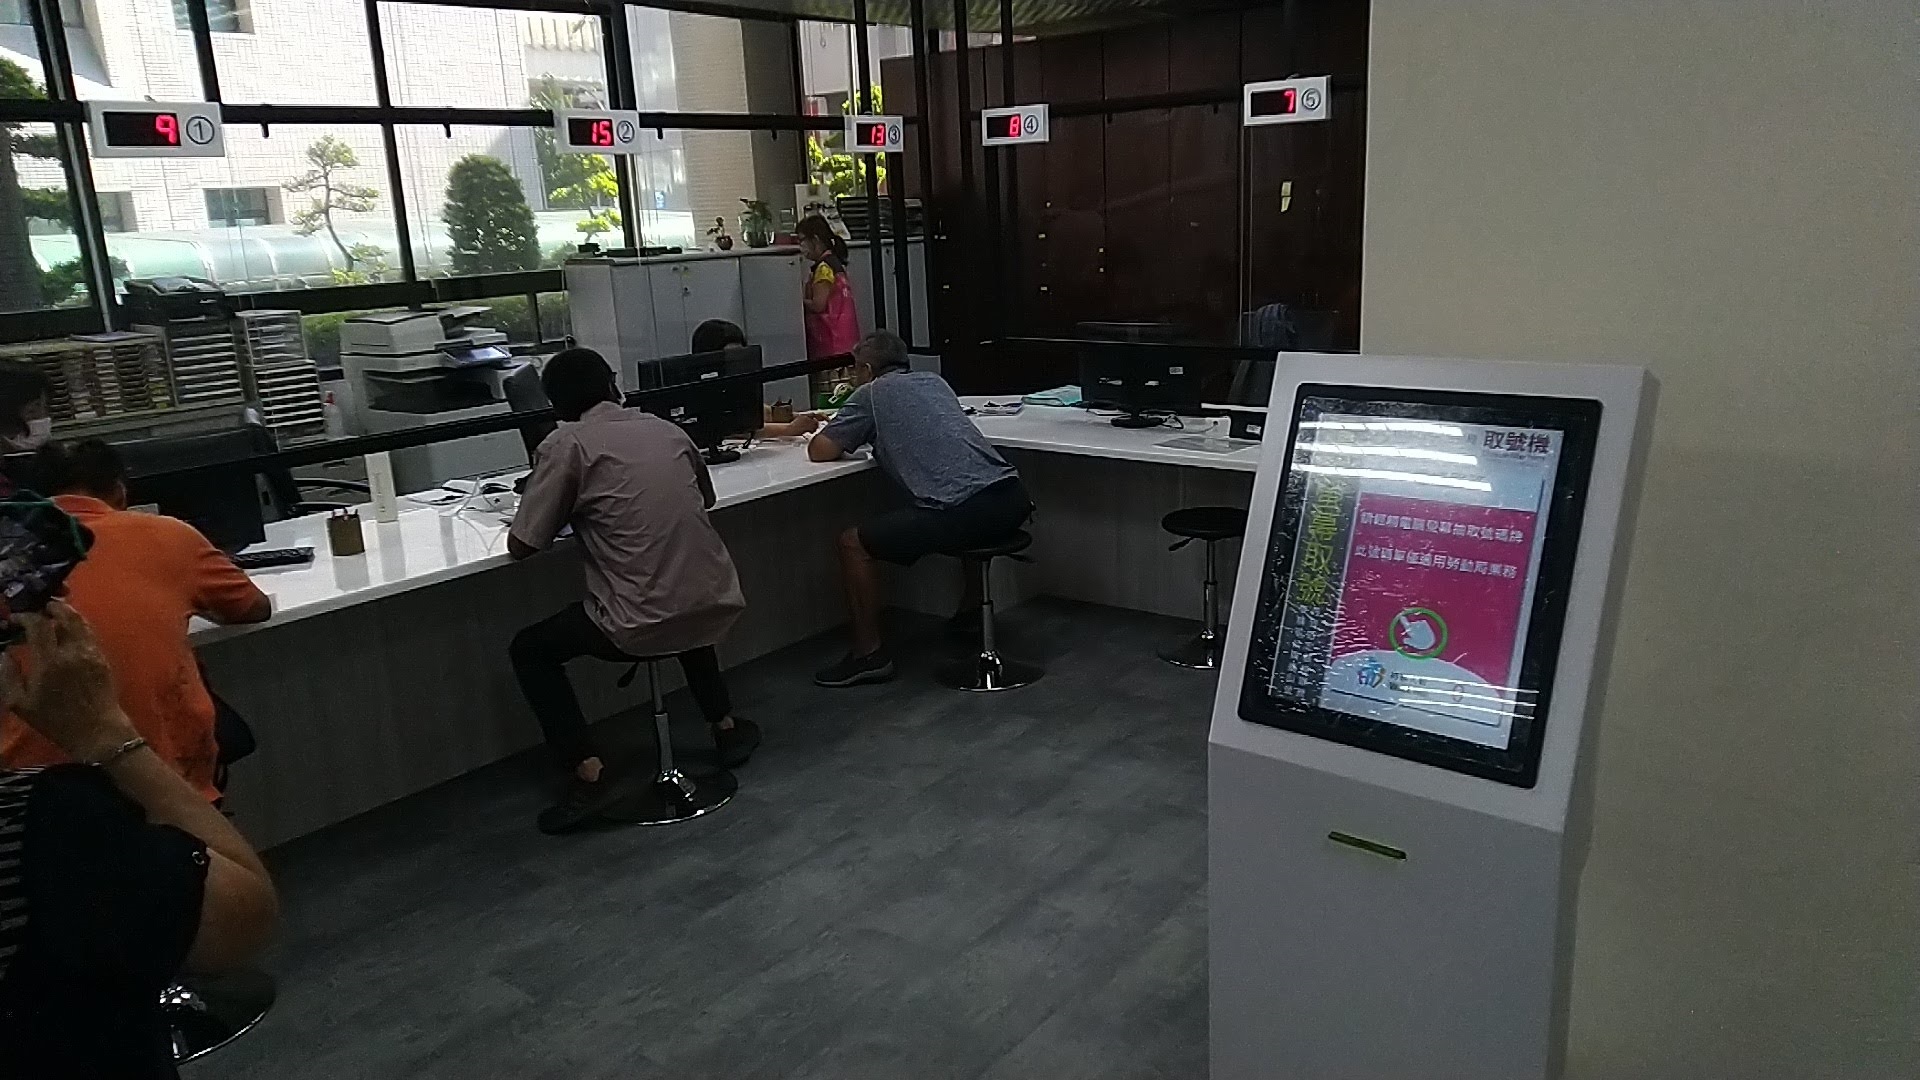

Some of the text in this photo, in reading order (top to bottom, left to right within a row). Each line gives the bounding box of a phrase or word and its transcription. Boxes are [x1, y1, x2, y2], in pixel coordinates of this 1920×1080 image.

[1283, 90, 1296, 113] 7
[155, 114, 178, 143] 9
[592, 120, 612, 146] 15
[871, 124, 885, 145] 13
[1009, 115, 1020, 137] 8
[1483, 430, 1551, 454] 取號機
